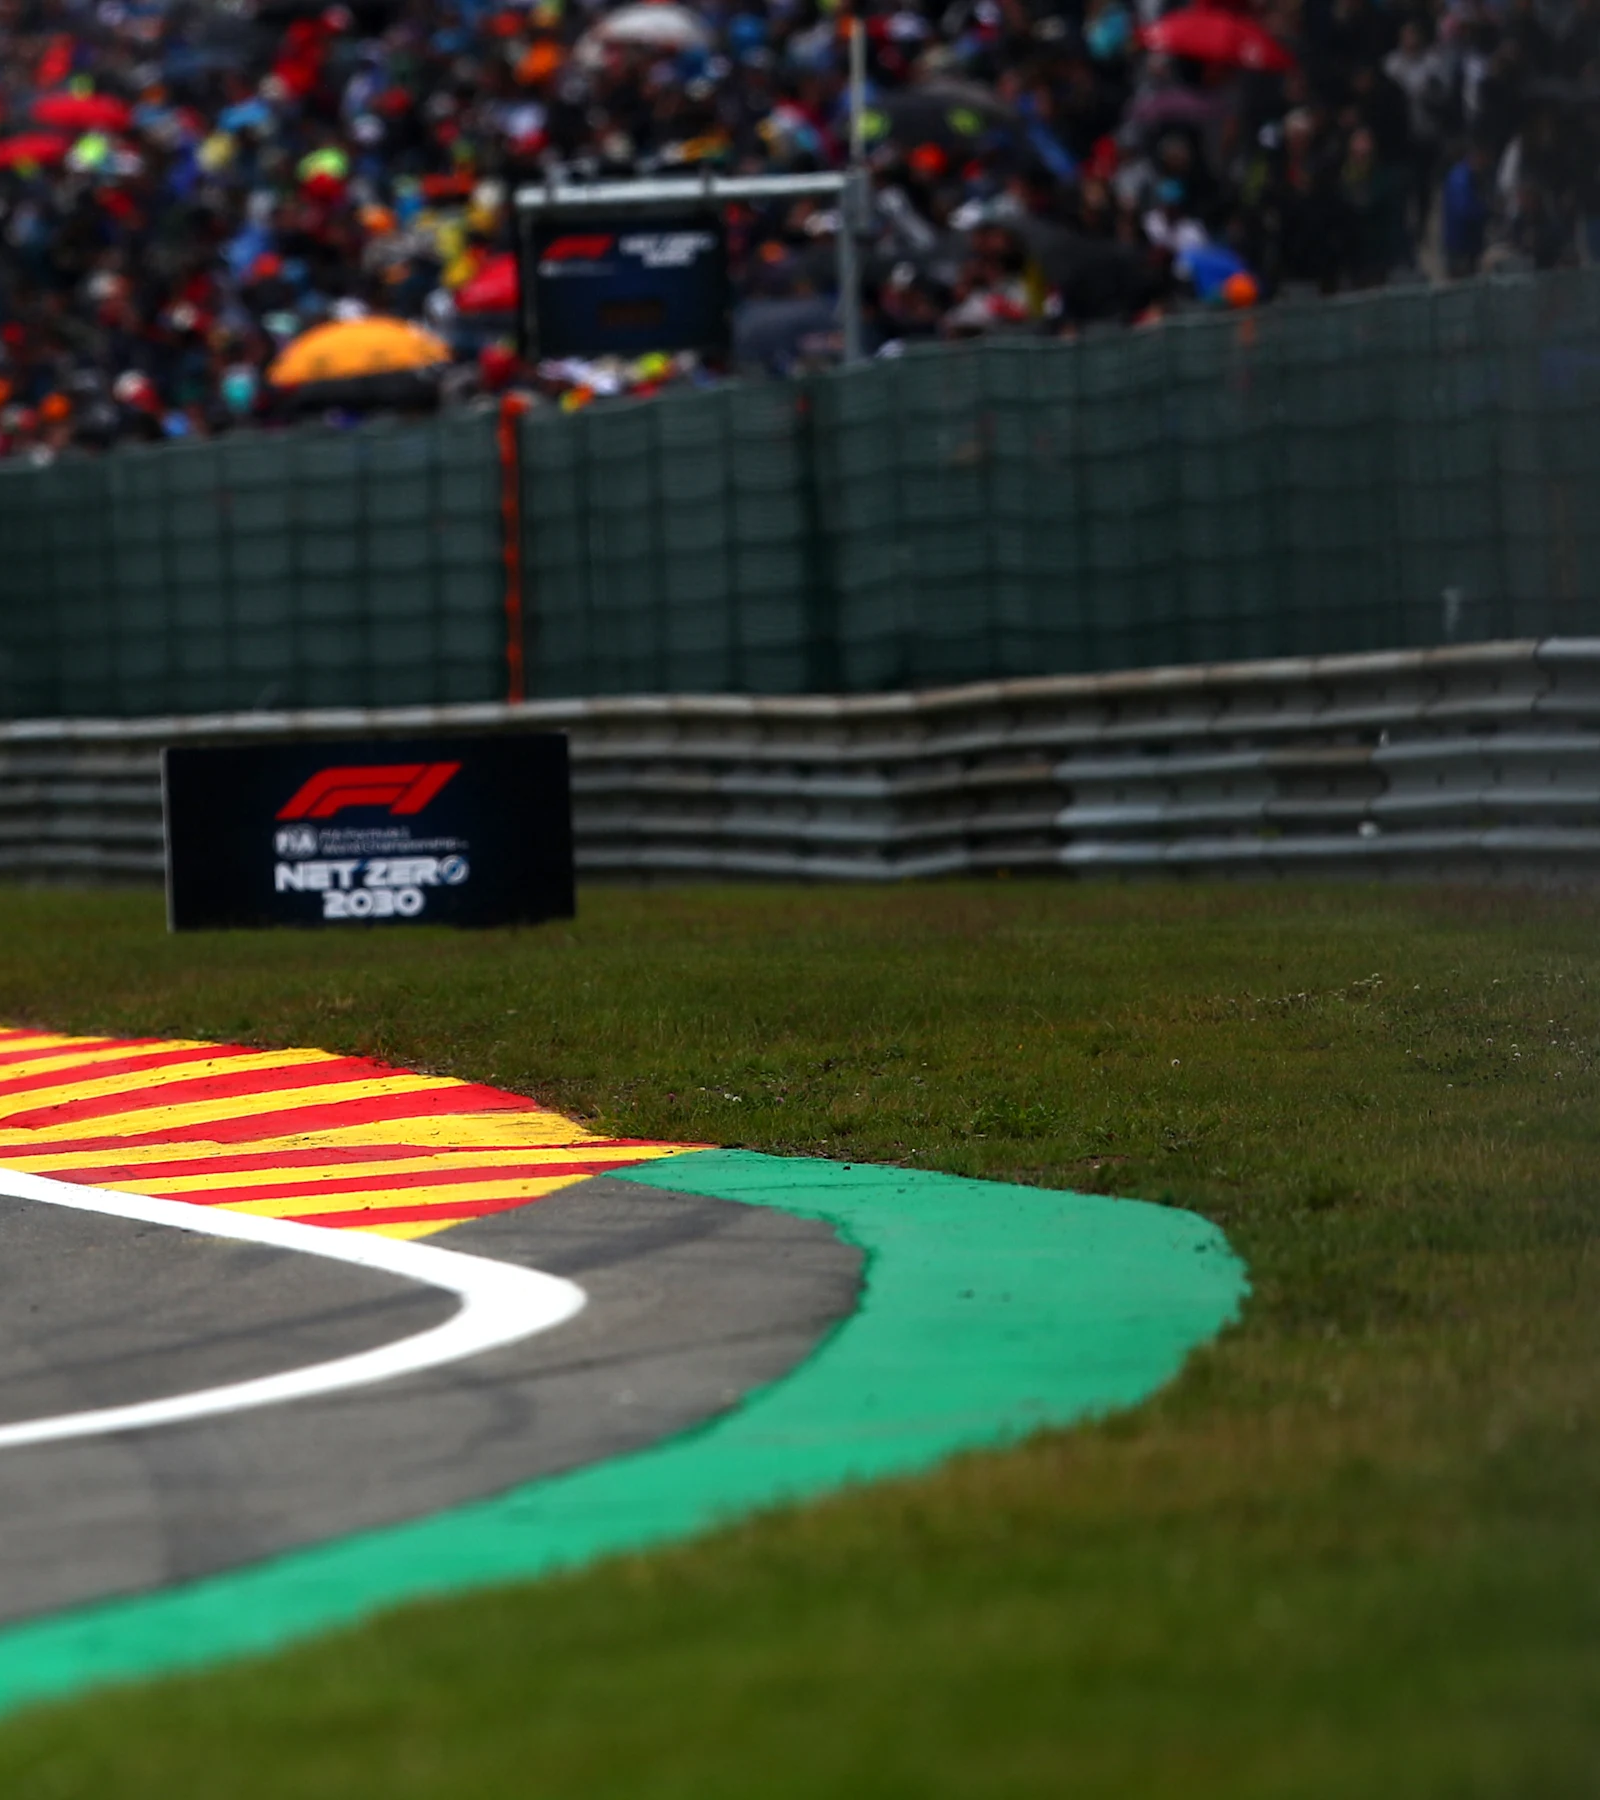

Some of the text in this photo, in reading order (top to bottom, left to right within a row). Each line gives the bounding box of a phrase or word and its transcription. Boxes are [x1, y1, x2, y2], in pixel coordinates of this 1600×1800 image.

[275, 762, 461, 820] F1
[274, 855, 470, 892] NET ZERO
[322, 886, 425, 918] 2030
